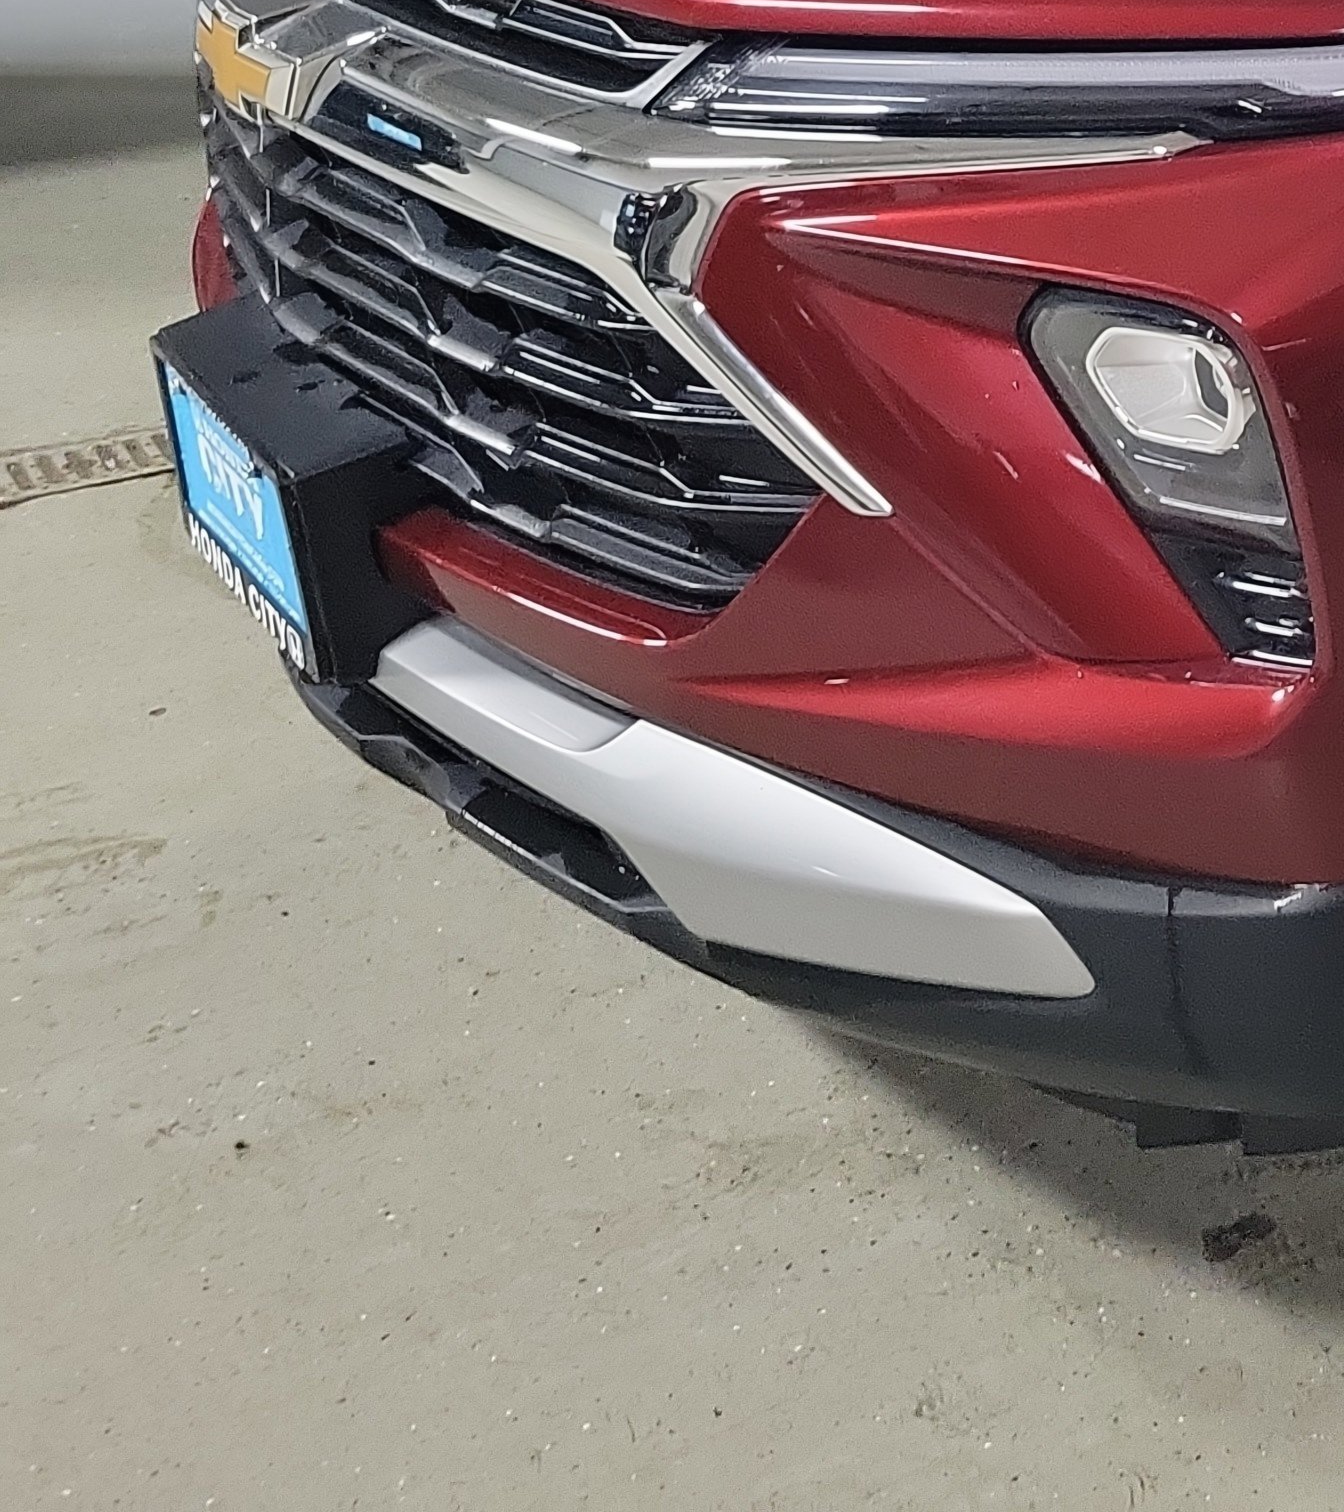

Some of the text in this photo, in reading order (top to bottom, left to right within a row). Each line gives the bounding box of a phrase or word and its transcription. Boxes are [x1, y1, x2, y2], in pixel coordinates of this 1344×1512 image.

[198, 433, 264, 541] CITY
[188, 513, 247, 604] HONDA
[248, 583, 287, 651] CITY
